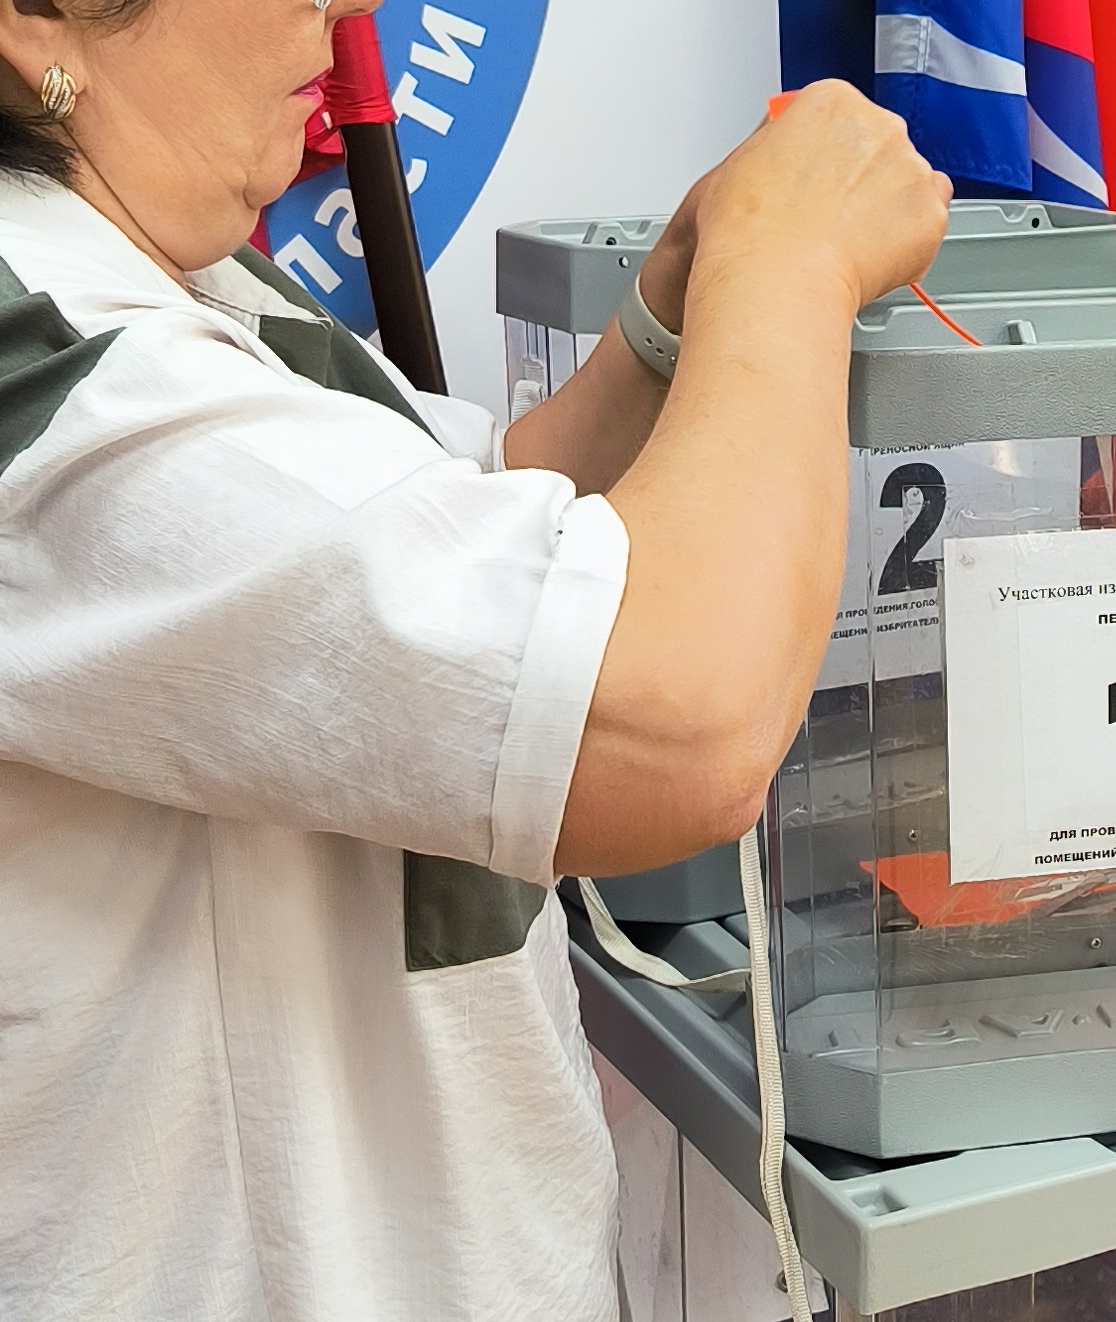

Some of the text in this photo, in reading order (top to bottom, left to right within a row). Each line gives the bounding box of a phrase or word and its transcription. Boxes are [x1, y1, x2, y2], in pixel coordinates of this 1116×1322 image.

[877, 461, 947, 596] 2
[998, 583, 1093, 602] Участковая
[1049, 829, 1077, 842] ДЛЯ
